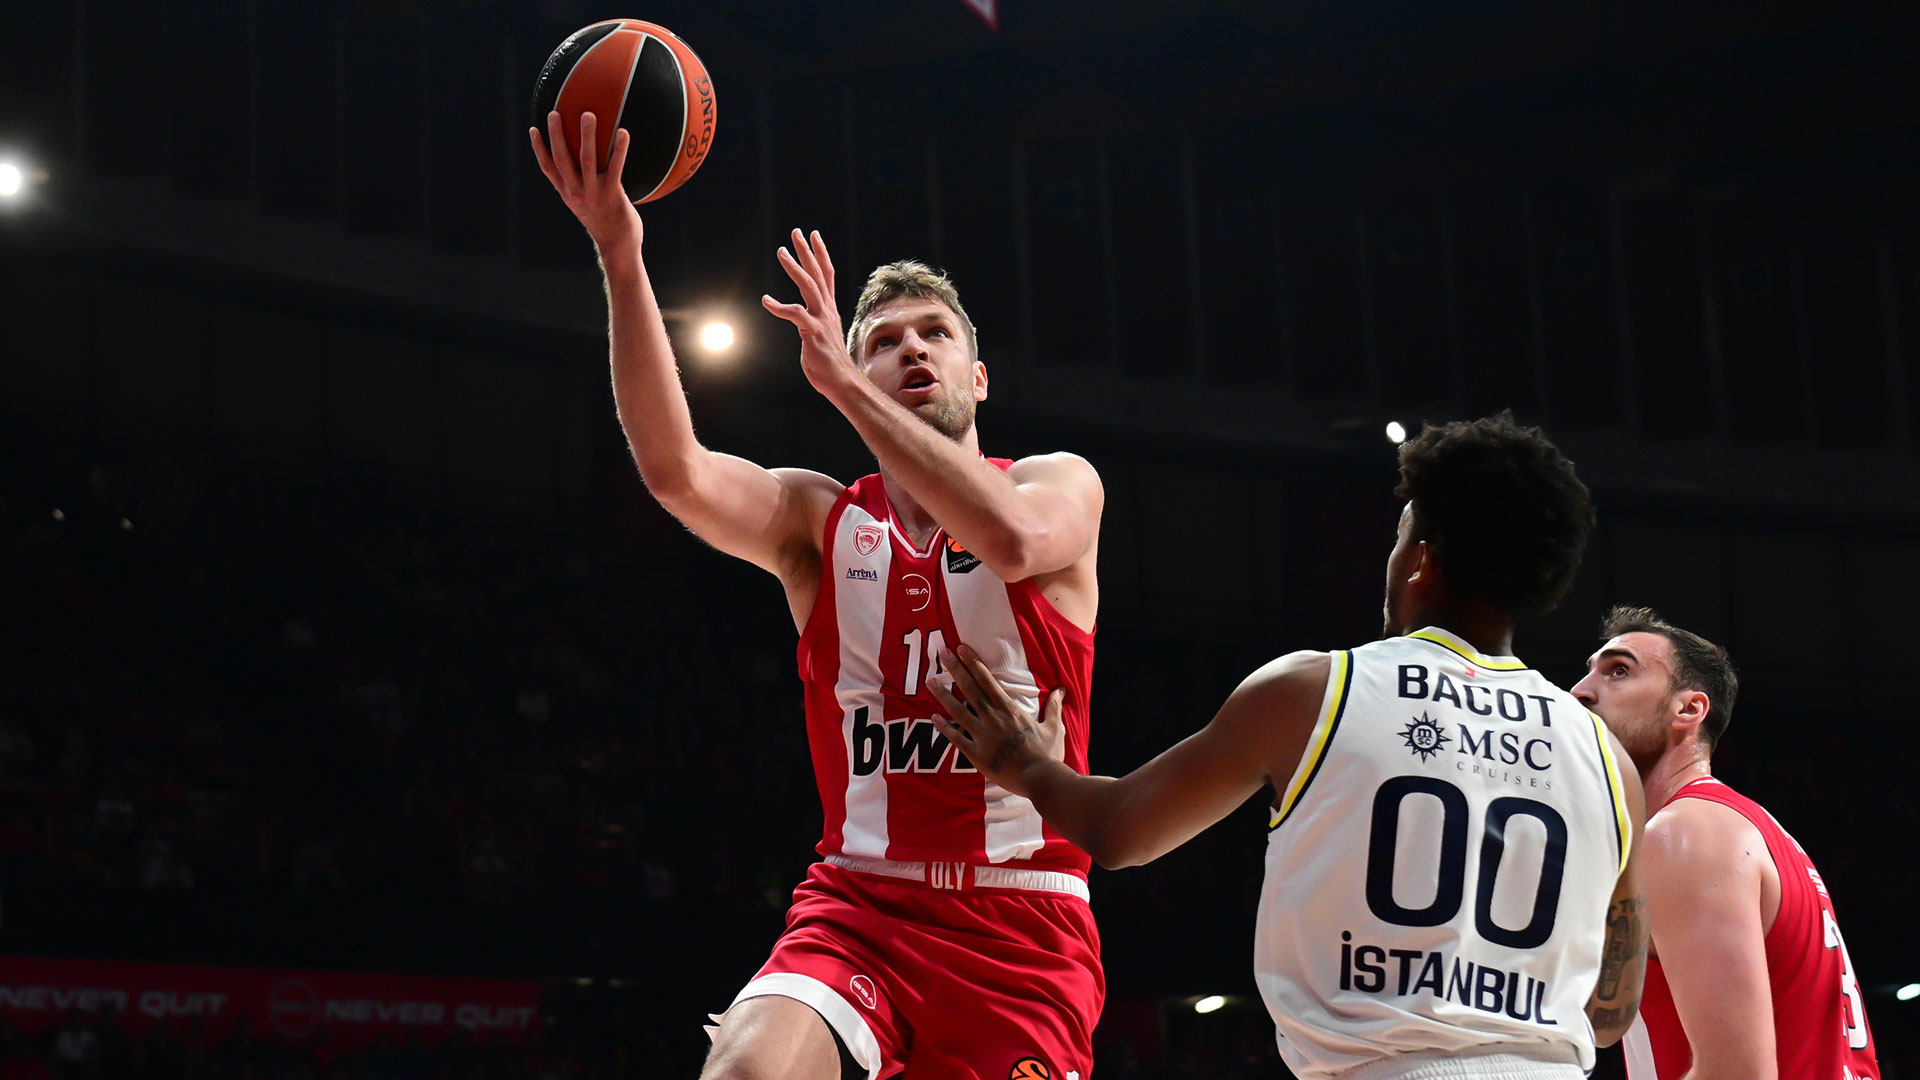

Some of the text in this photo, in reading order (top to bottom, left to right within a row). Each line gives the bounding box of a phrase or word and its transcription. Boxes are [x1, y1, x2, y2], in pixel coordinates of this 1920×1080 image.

[904, 628, 957, 697] 14
[1397, 664, 1555, 727] BACOT
[1456, 723, 1552, 771] MSC
[1456, 761, 1552, 791] CRUISES
[931, 861, 966, 890] OLY
[1365, 775, 1568, 949] 00
[0, 985, 229, 1018] NEVER QUIT
[325, 998, 447, 1024] NEVER
[455, 1002, 537, 1030] QUIT
